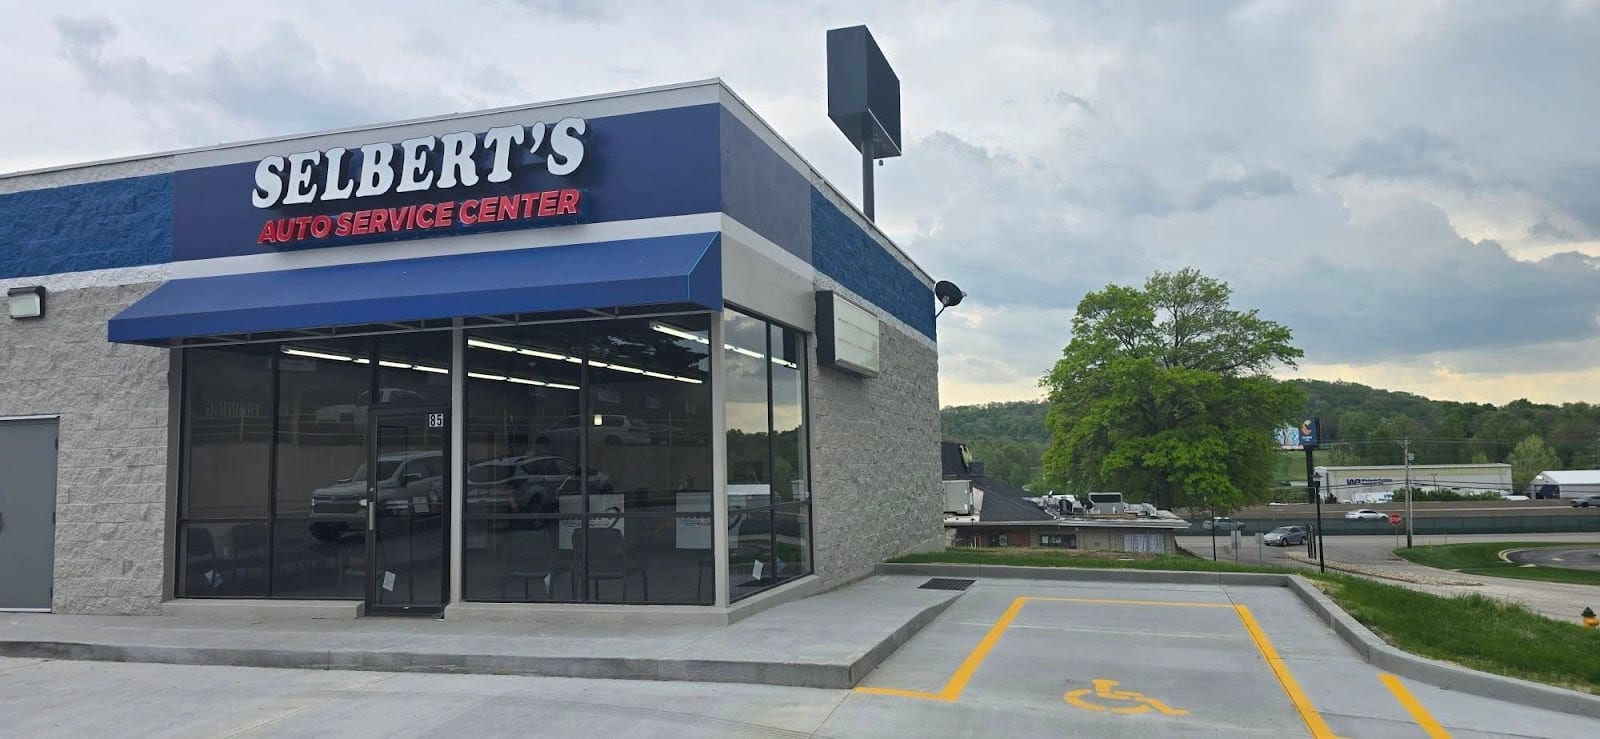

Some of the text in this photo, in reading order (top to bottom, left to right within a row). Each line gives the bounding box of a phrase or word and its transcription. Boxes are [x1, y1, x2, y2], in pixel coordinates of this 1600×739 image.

[252, 117, 586, 208] SELBERT'S
[257, 189, 580, 244] AUTO SERVICE CENTER
[430, 414, 442, 426] 85
